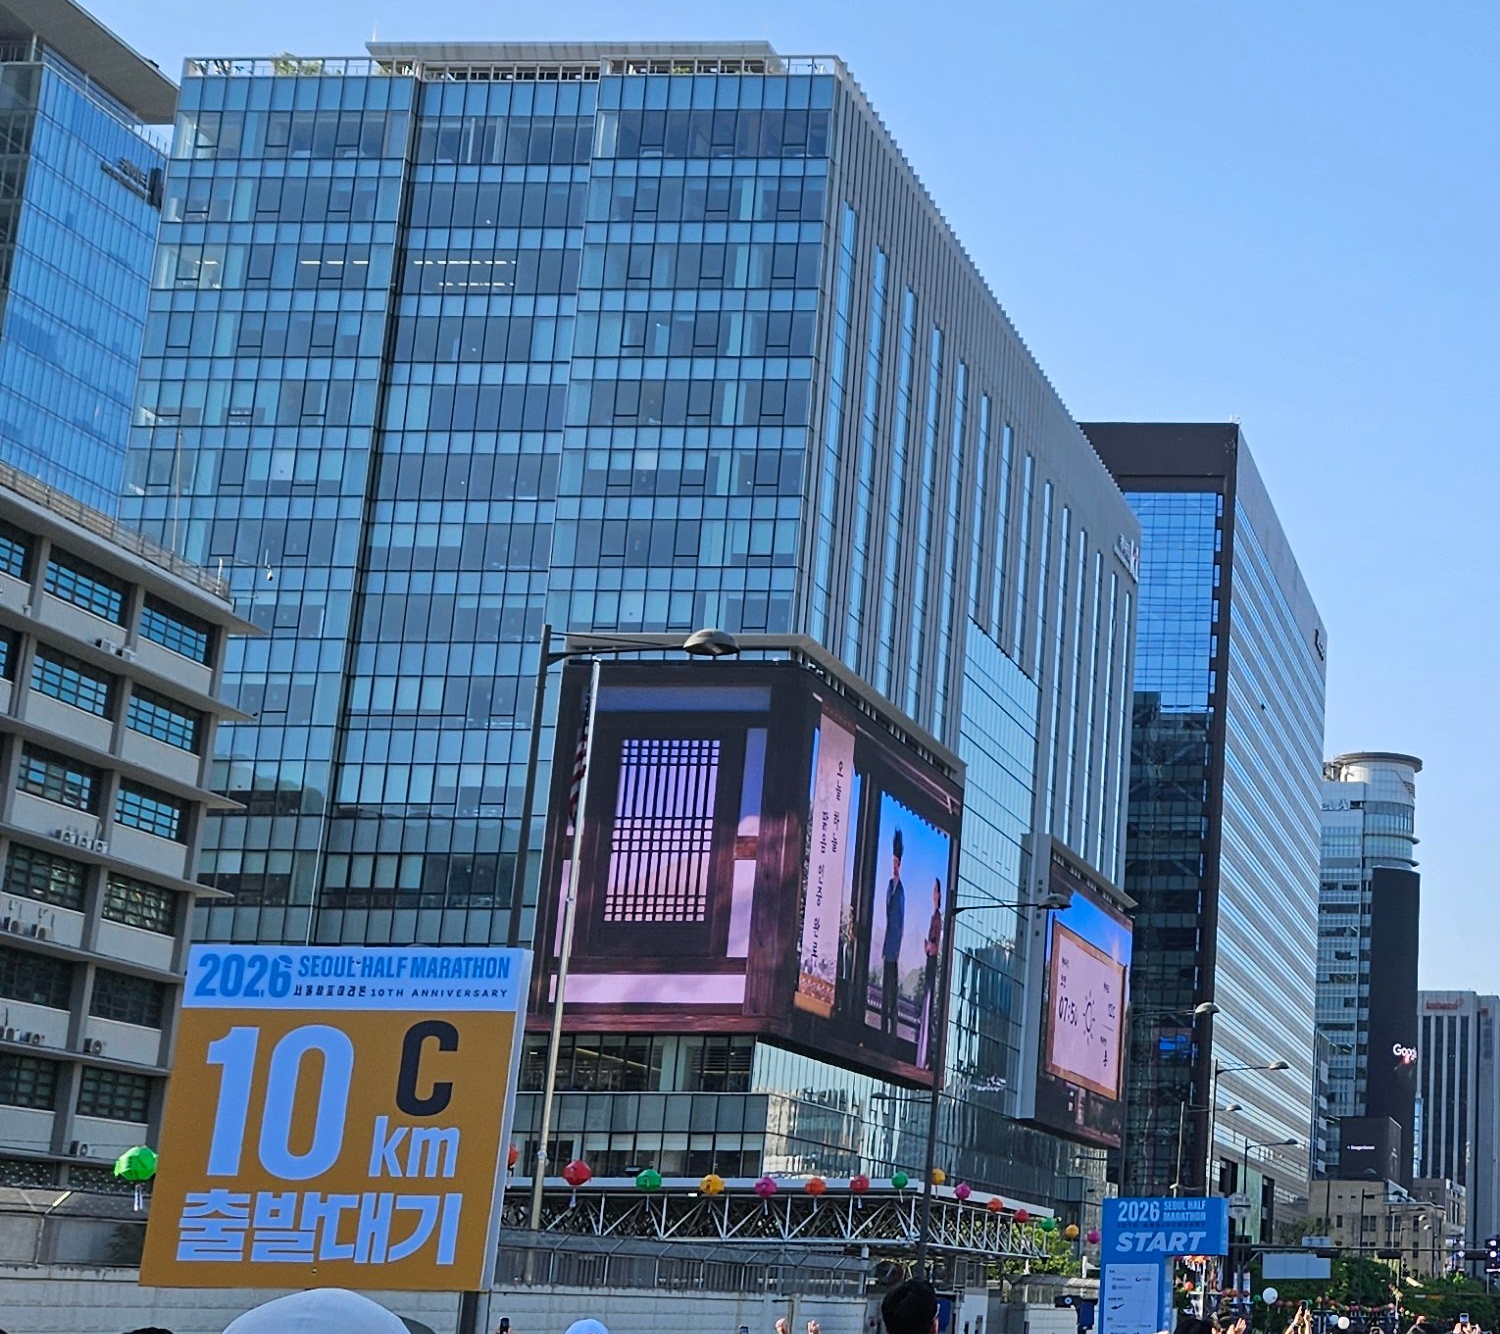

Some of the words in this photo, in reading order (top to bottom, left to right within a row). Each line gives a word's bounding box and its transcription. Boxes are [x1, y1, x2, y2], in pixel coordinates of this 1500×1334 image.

[194, 953, 293, 998] 2026
[297, 955, 354, 978] SEOUL
[360, 956, 407, 979] HALF
[410, 956, 510, 980] MARATHON
[371, 988, 404, 998] 10TH
[411, 988, 508, 998] ANNIVERSARY
[396, 1020, 459, 1117] C
[206, 1024, 355, 1181] 10
[368, 1115, 461, 1179] km
[176, 1188, 463, 1265] 출발대기
[1118, 1201, 1160, 1222] 2026
[1164, 1200, 1186, 1210] SEOUL
[1187, 1200, 1206, 1210] HALF
[1163, 1212, 1206, 1222] MARATHON
[1116, 1231, 1206, 1252] START
